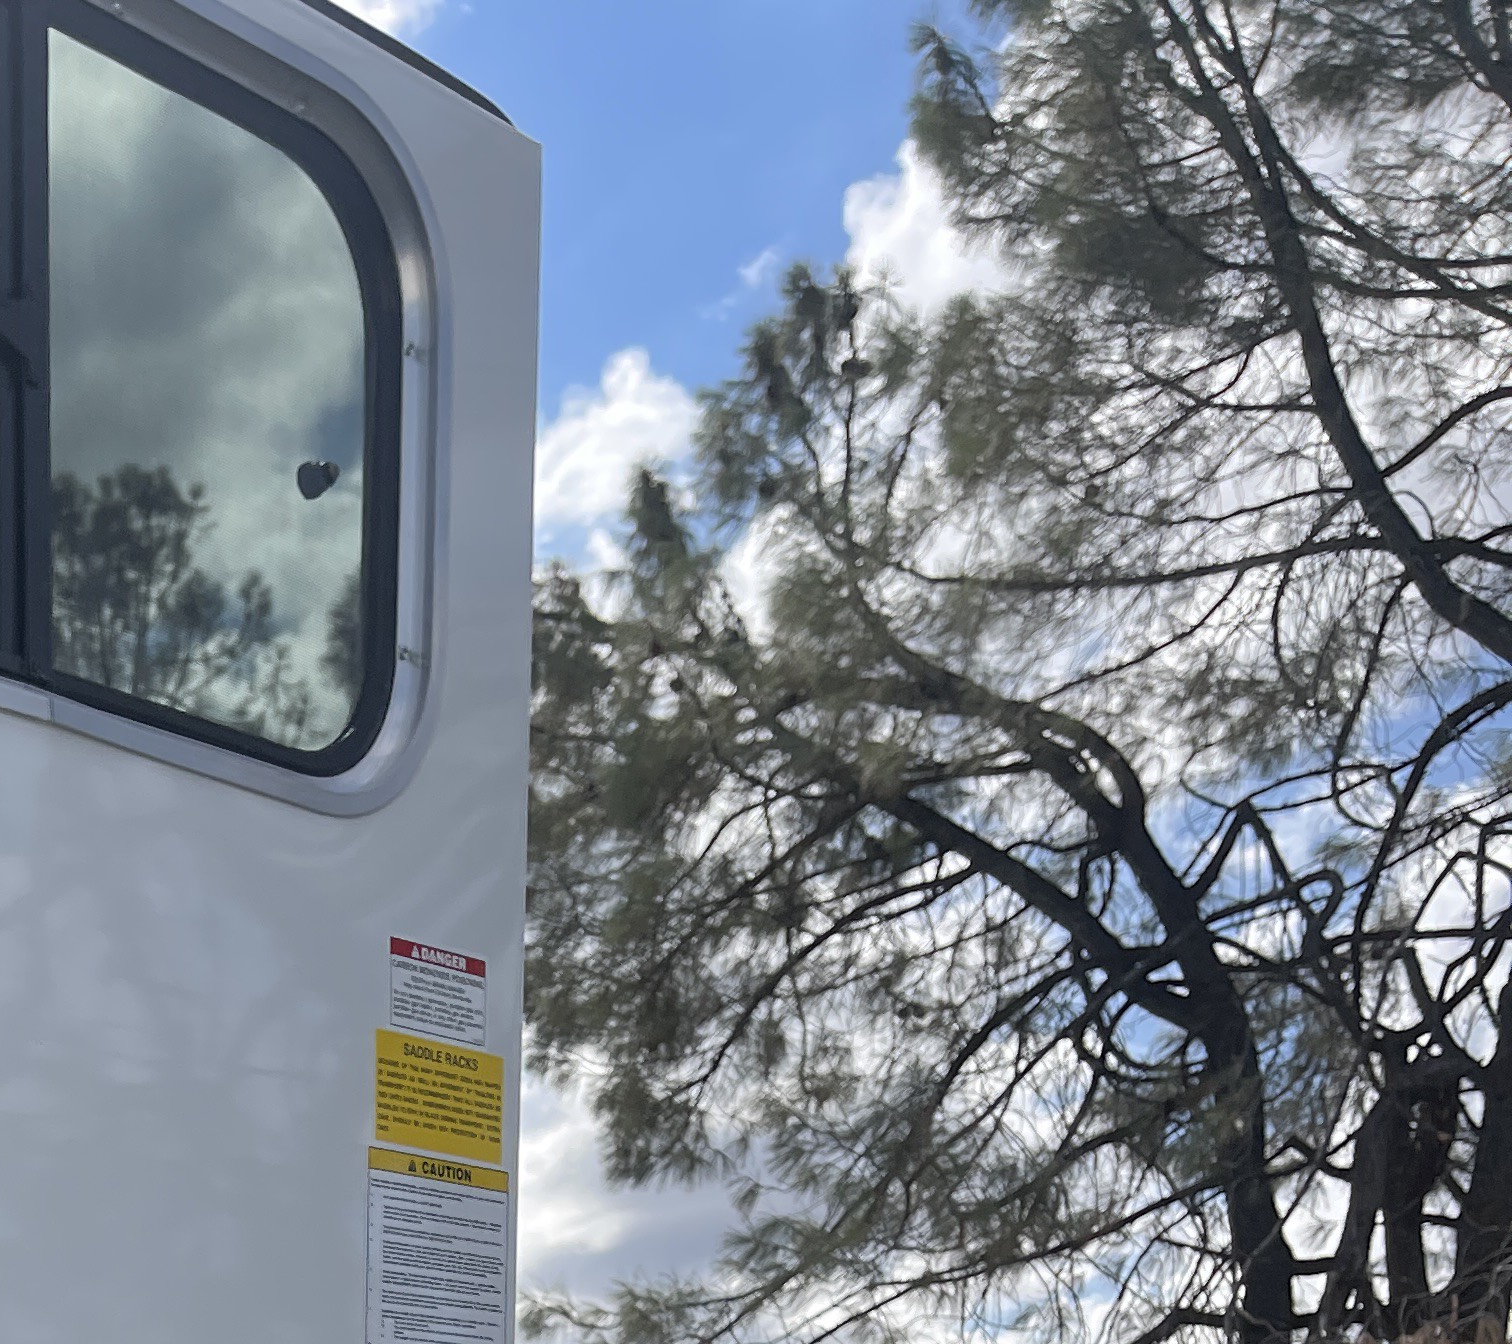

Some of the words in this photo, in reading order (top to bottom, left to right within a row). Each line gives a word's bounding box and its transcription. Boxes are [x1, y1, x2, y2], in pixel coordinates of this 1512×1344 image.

[421, 947, 467, 971] DANGER
[403, 1042, 443, 1063] SADDLE
[445, 1052, 479, 1072] RACKS
[422, 1161, 472, 1182] CAUTION
